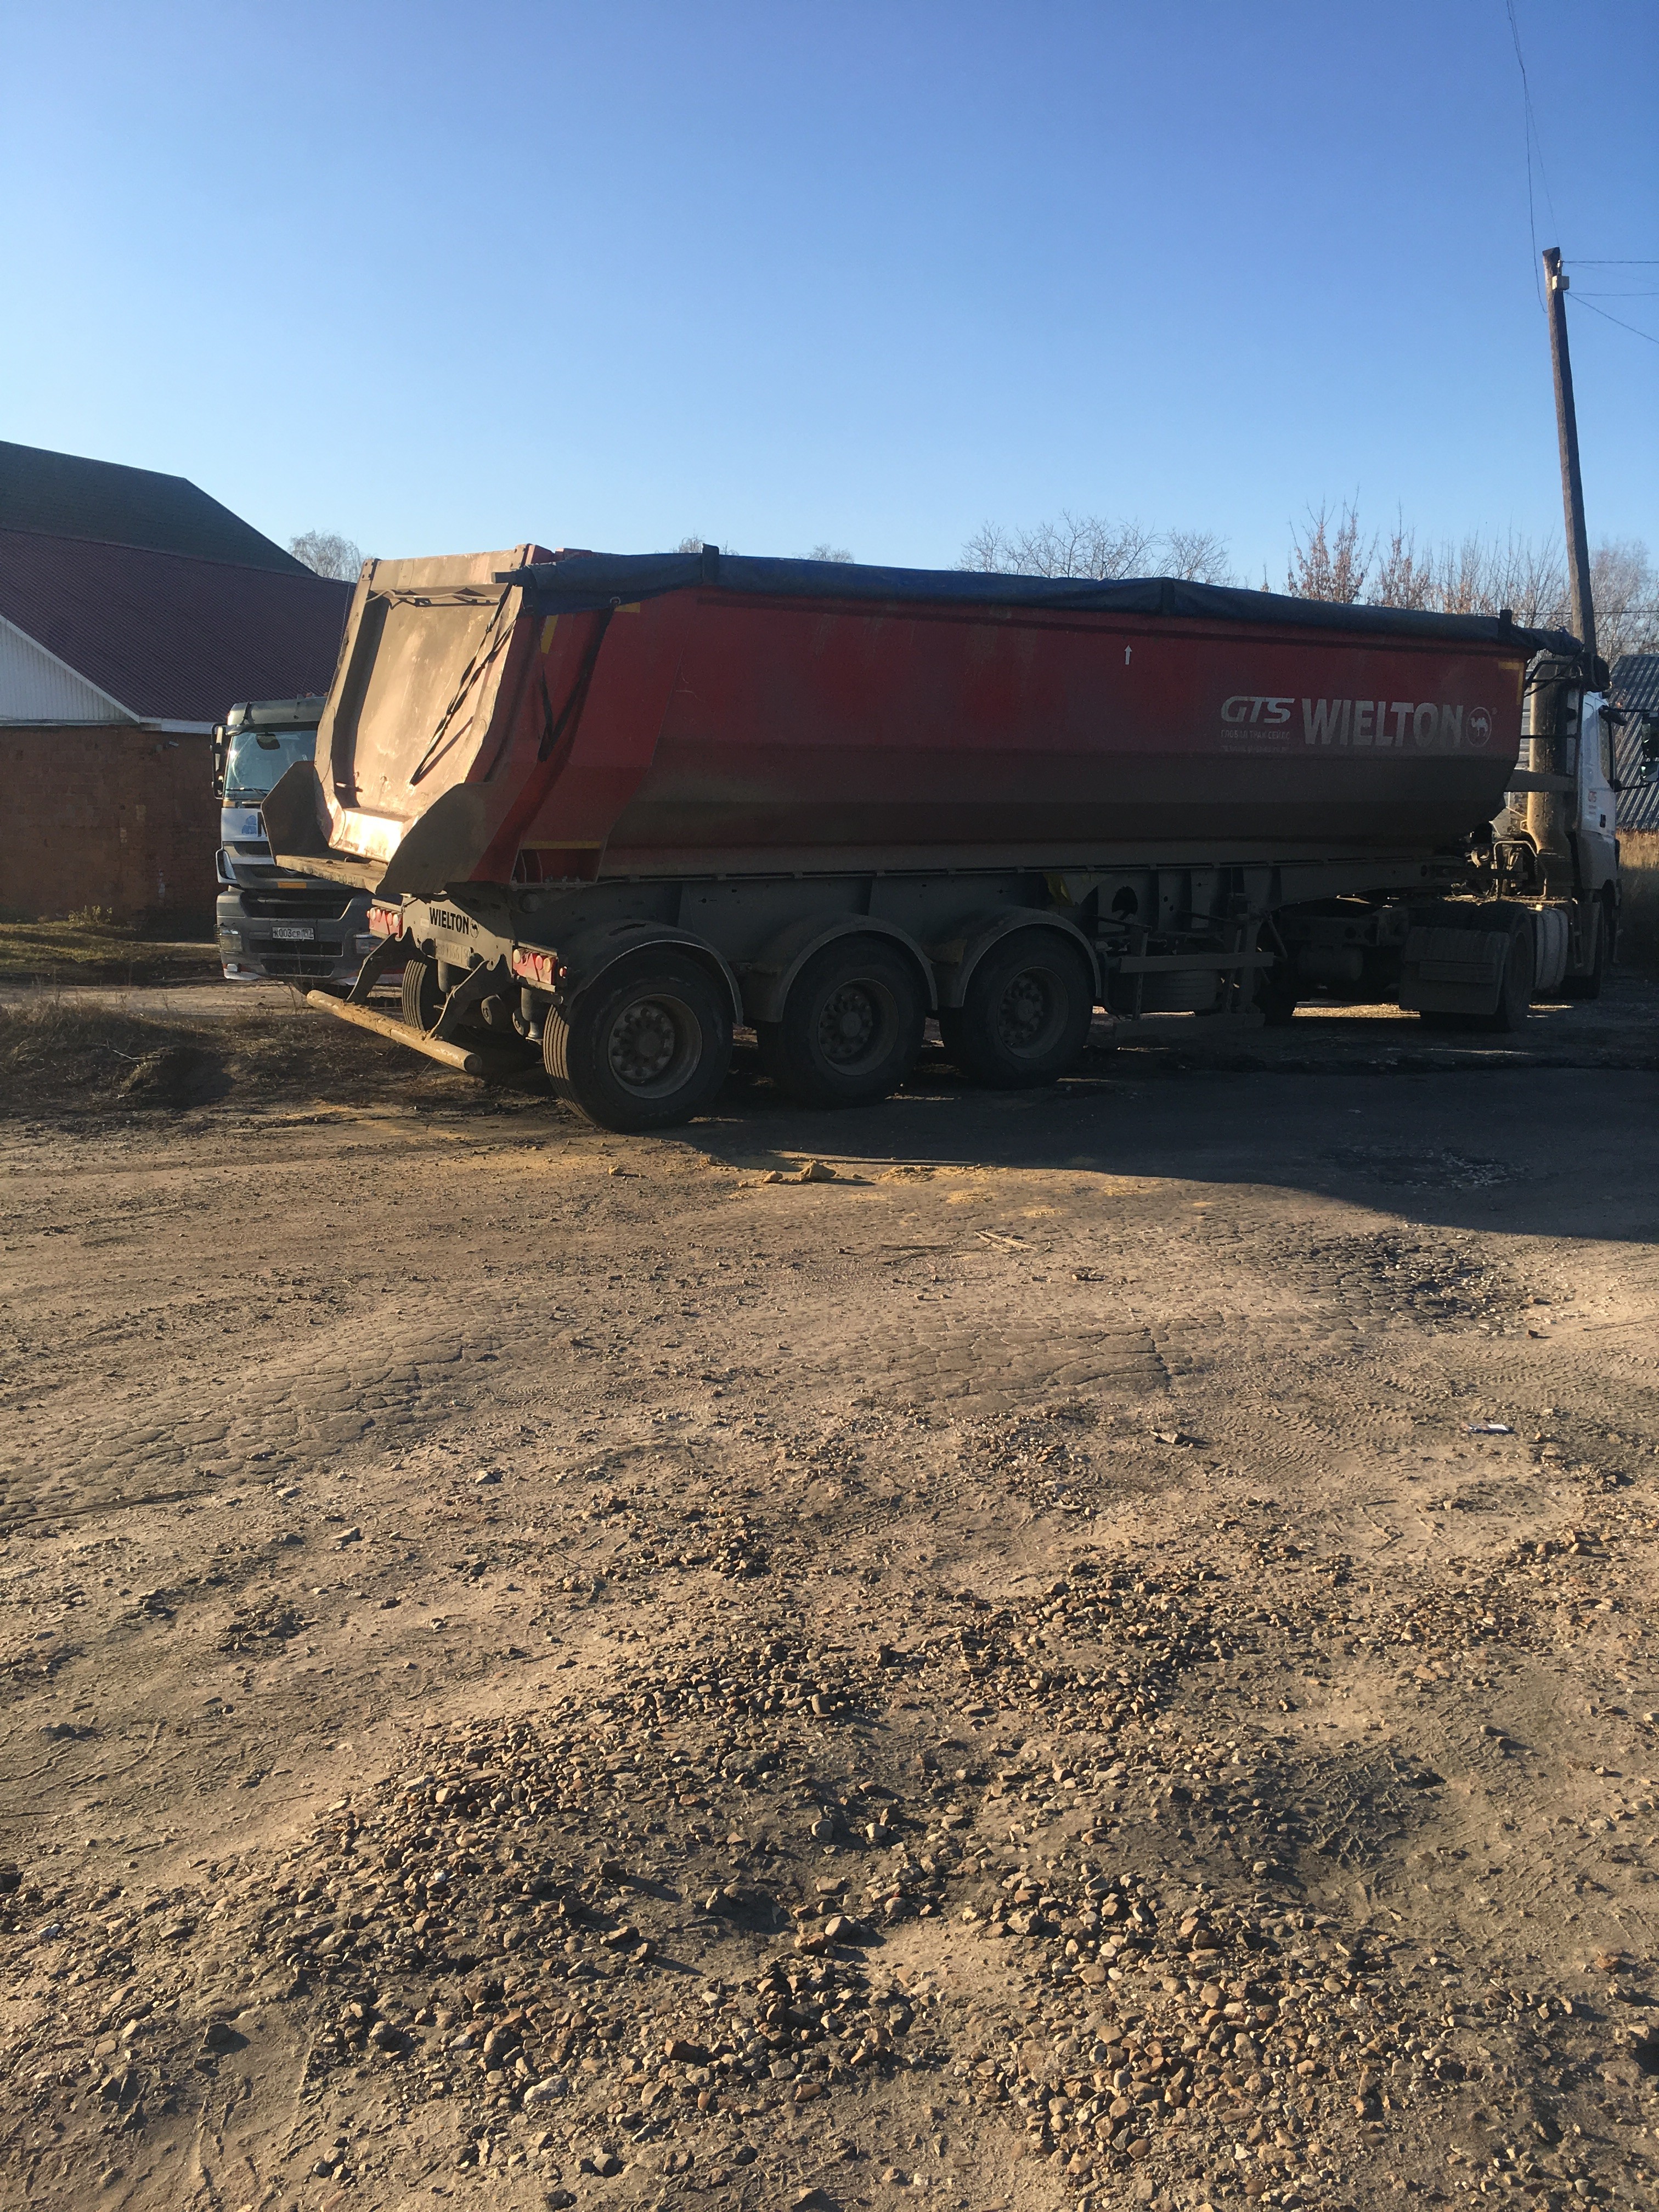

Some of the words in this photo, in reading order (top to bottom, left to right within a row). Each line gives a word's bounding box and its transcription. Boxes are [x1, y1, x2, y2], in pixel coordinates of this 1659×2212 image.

[1221, 695, 1296, 724] GTS
[1301, 698, 1464, 748] WIELTON
[429, 907, 469, 935] WIELTON
